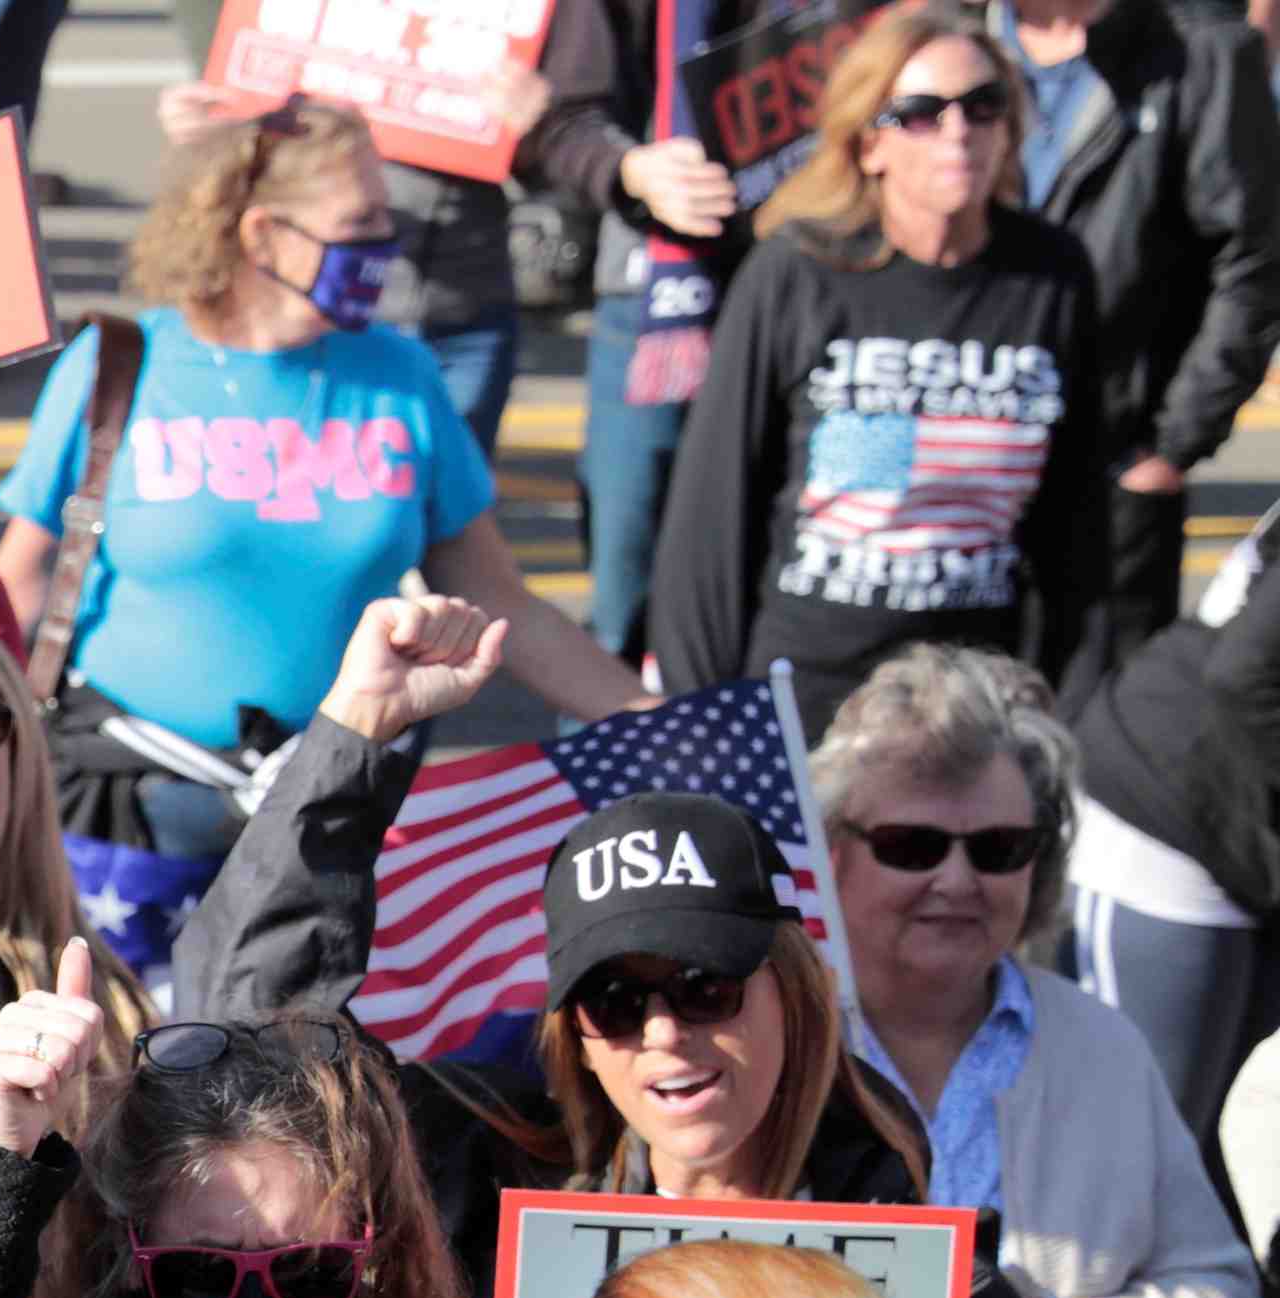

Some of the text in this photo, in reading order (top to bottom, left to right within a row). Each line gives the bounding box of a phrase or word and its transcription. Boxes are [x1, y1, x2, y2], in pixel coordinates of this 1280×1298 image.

[808, 337, 1062, 393] JESUS
[130, 417, 414, 521] USMC
[572, 829, 717, 903] USA
